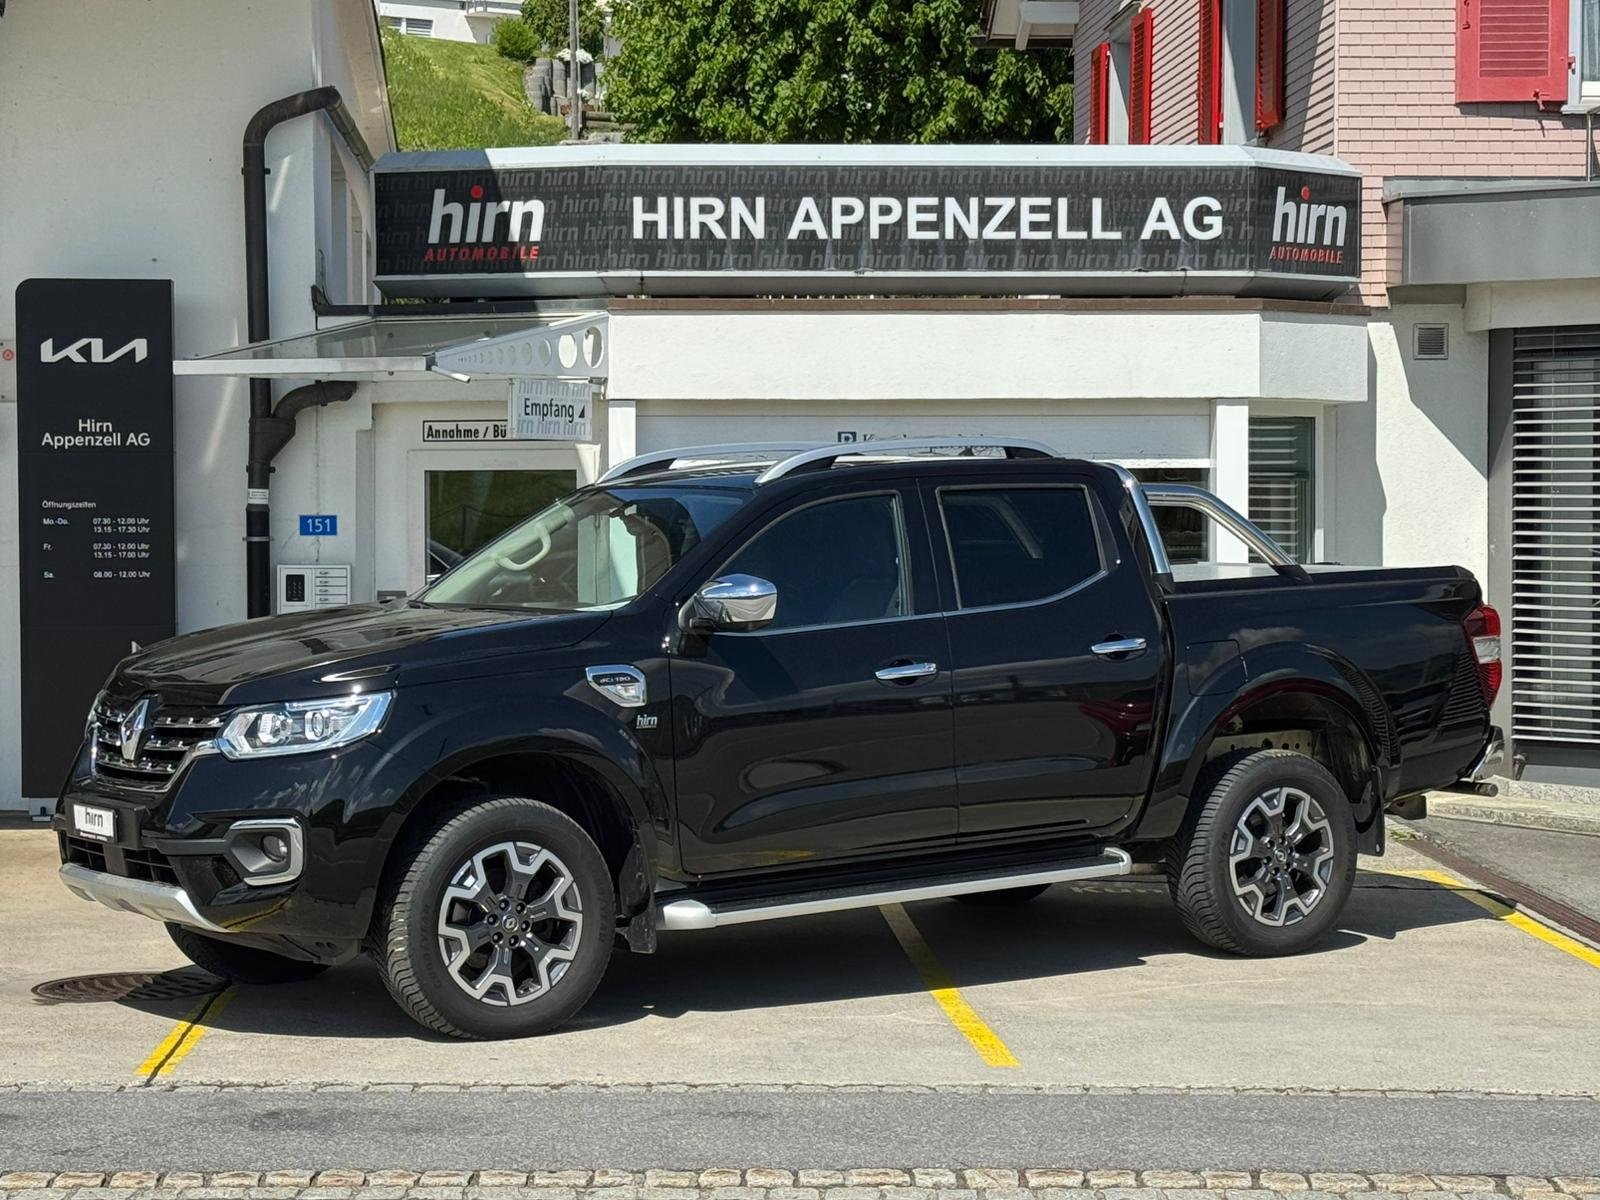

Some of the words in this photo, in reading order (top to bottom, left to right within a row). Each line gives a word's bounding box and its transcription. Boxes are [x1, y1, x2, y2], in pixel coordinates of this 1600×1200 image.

[427, 185, 545, 244] hirn
[632, 196, 765, 240] HIRN
[786, 196, 1122, 240] APPENZELL
[1139, 195, 1223, 241] AG
[1272, 185, 1347, 247] hirn
[423, 245, 540, 262] AUTOMOBILE
[1268, 246, 1344, 264] AUTOMOBILE
[524, 398, 574, 423] Empfang
[78, 419, 112, 432] Hirn
[426, 424, 479, 439] Annahme
[483, 426, 489, 439] /
[493, 424, 507, 438] Bü
[41, 432, 121, 449] Appenzell
[126, 432, 150, 446] AG
[42, 500, 97, 510] Öffnungszeiten
[307, 518, 330, 532] 151
[637, 714, 658, 726] hirn
[85, 807, 103, 827] hirn
